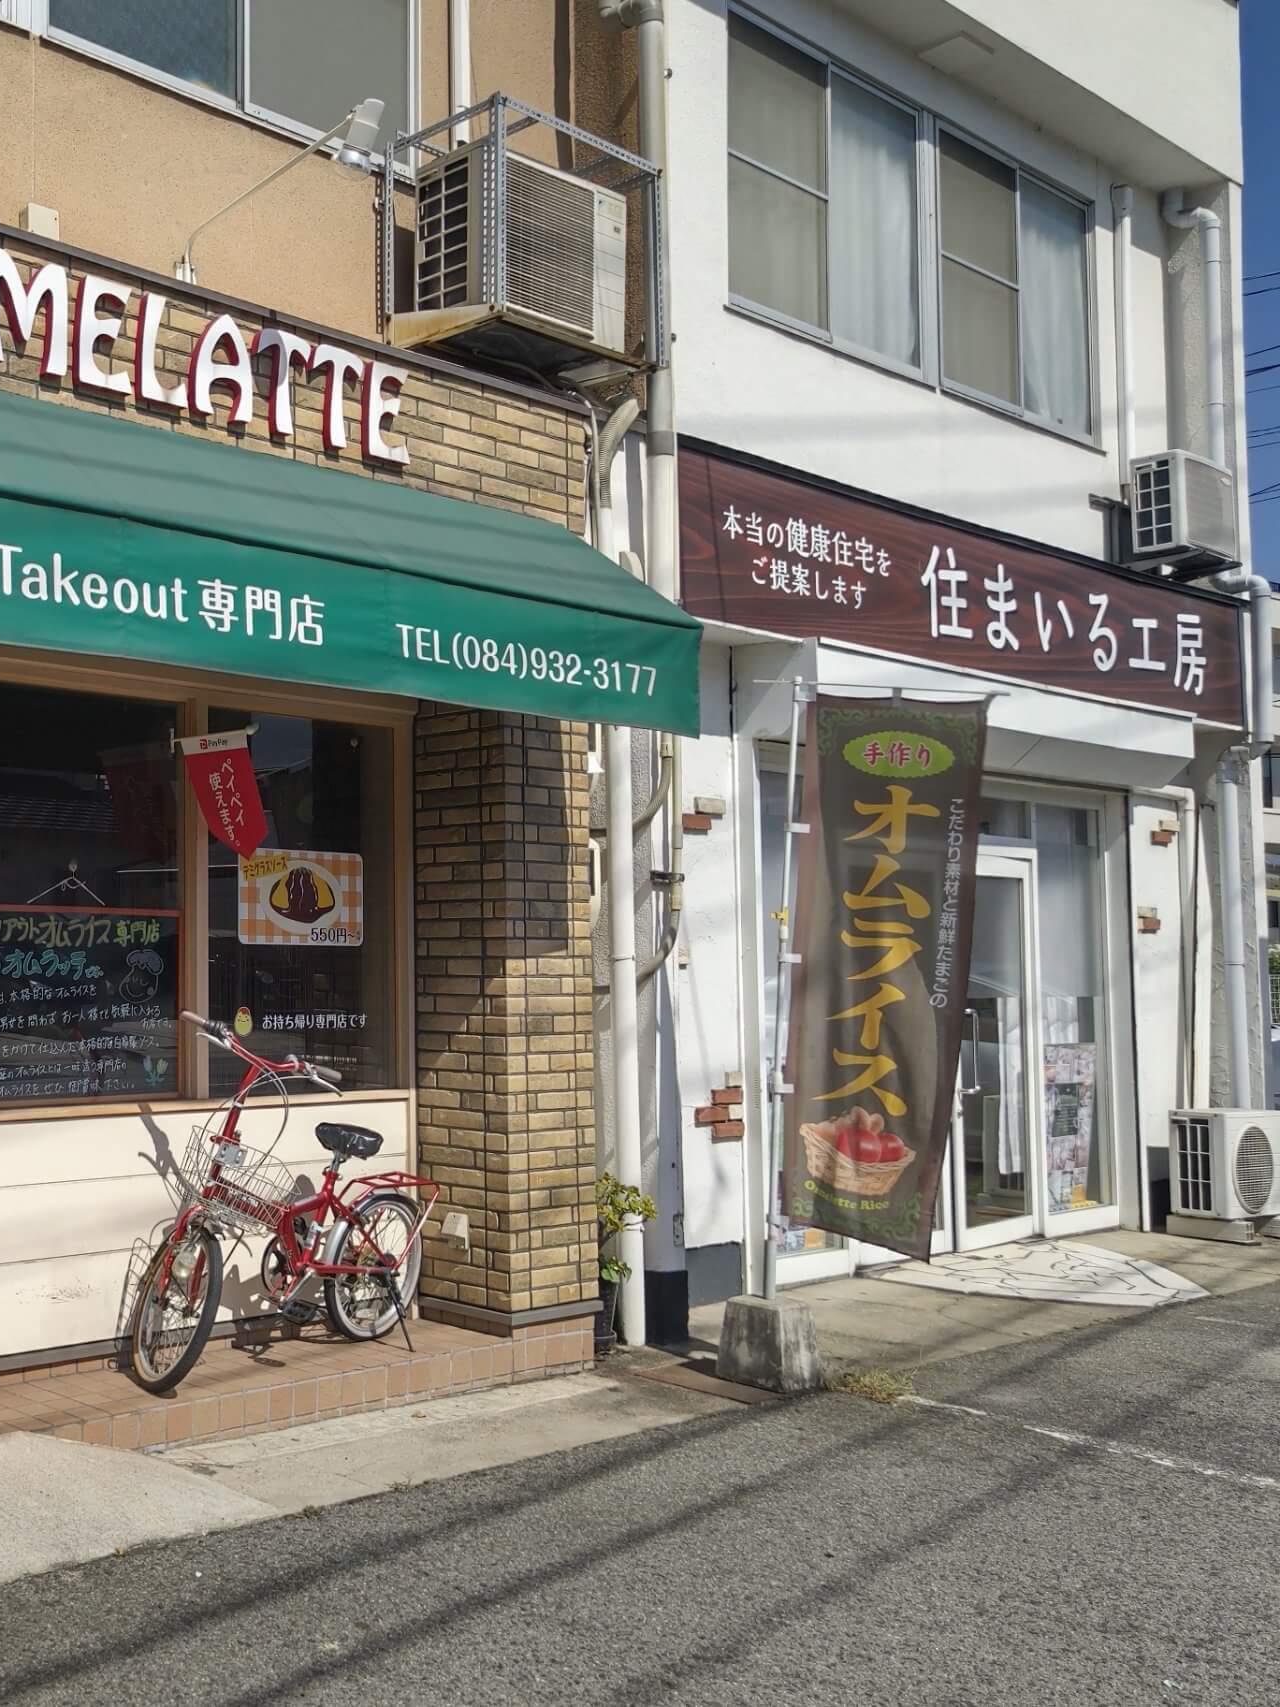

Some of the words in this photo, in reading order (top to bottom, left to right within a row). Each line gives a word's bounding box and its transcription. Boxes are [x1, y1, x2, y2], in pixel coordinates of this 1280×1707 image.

[722, 504, 893, 578] 本当の健康住宅を
[751, 556, 868, 610] ご提案します
[920, 544, 1208, 697] 住まいる工房
[863, 740, 933, 769] 手作り
[208, 772, 241, 847] 使えます。
[221, 758, 246, 827] ペイペイ
[812, 784, 941, 1118] オムライス
[262, 1013, 368, 1030] お持ち帰り専門店です
